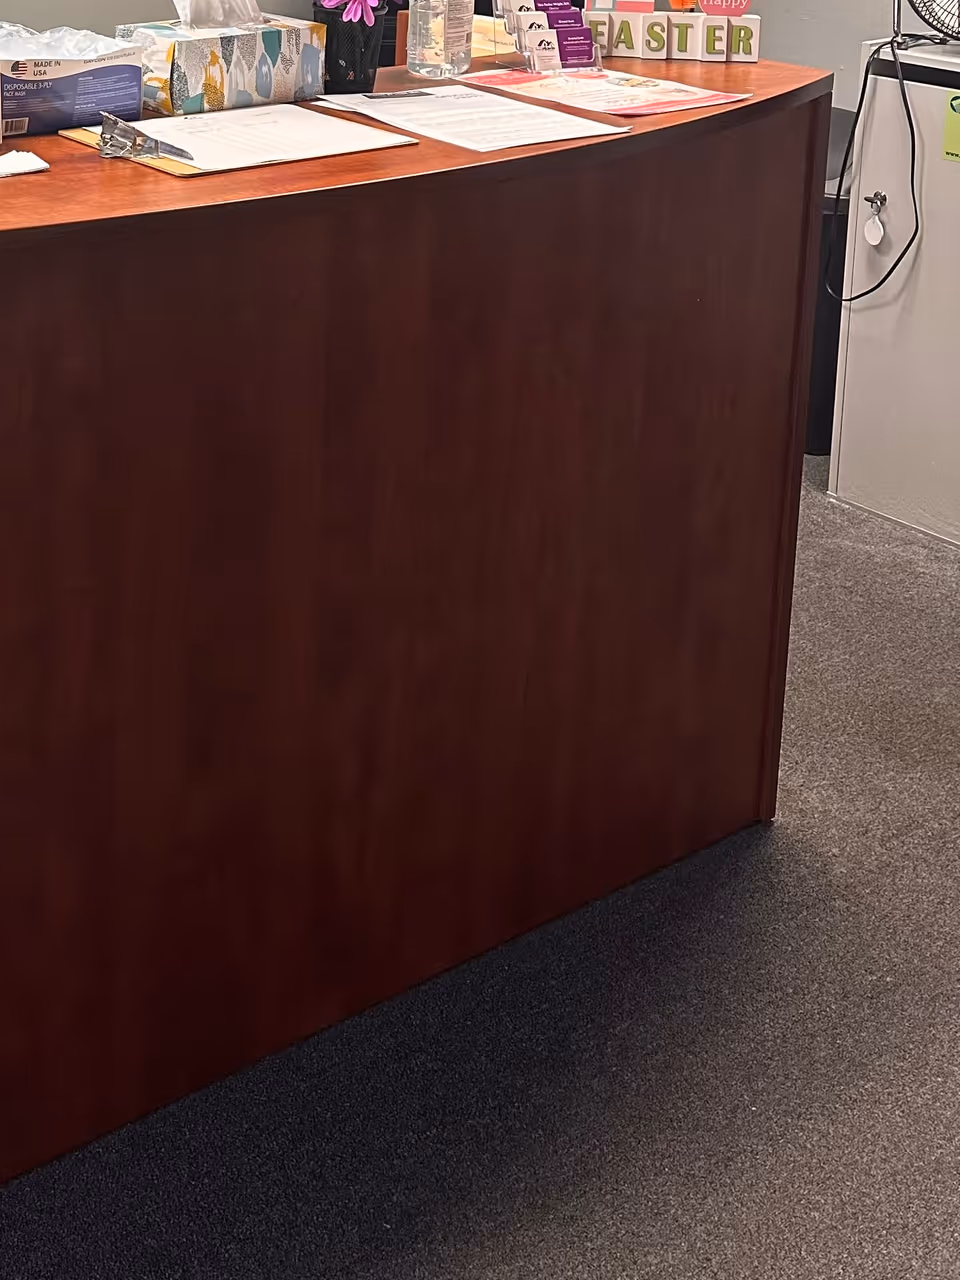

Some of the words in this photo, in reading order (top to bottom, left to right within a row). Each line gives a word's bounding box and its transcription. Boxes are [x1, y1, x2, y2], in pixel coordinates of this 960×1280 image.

[33, 60, 52, 68] MADE
[33, 69, 47, 77] USA
[3, 83, 38, 91] DISPOSABLE
[38, 81, 53, 90] 3-PLY
